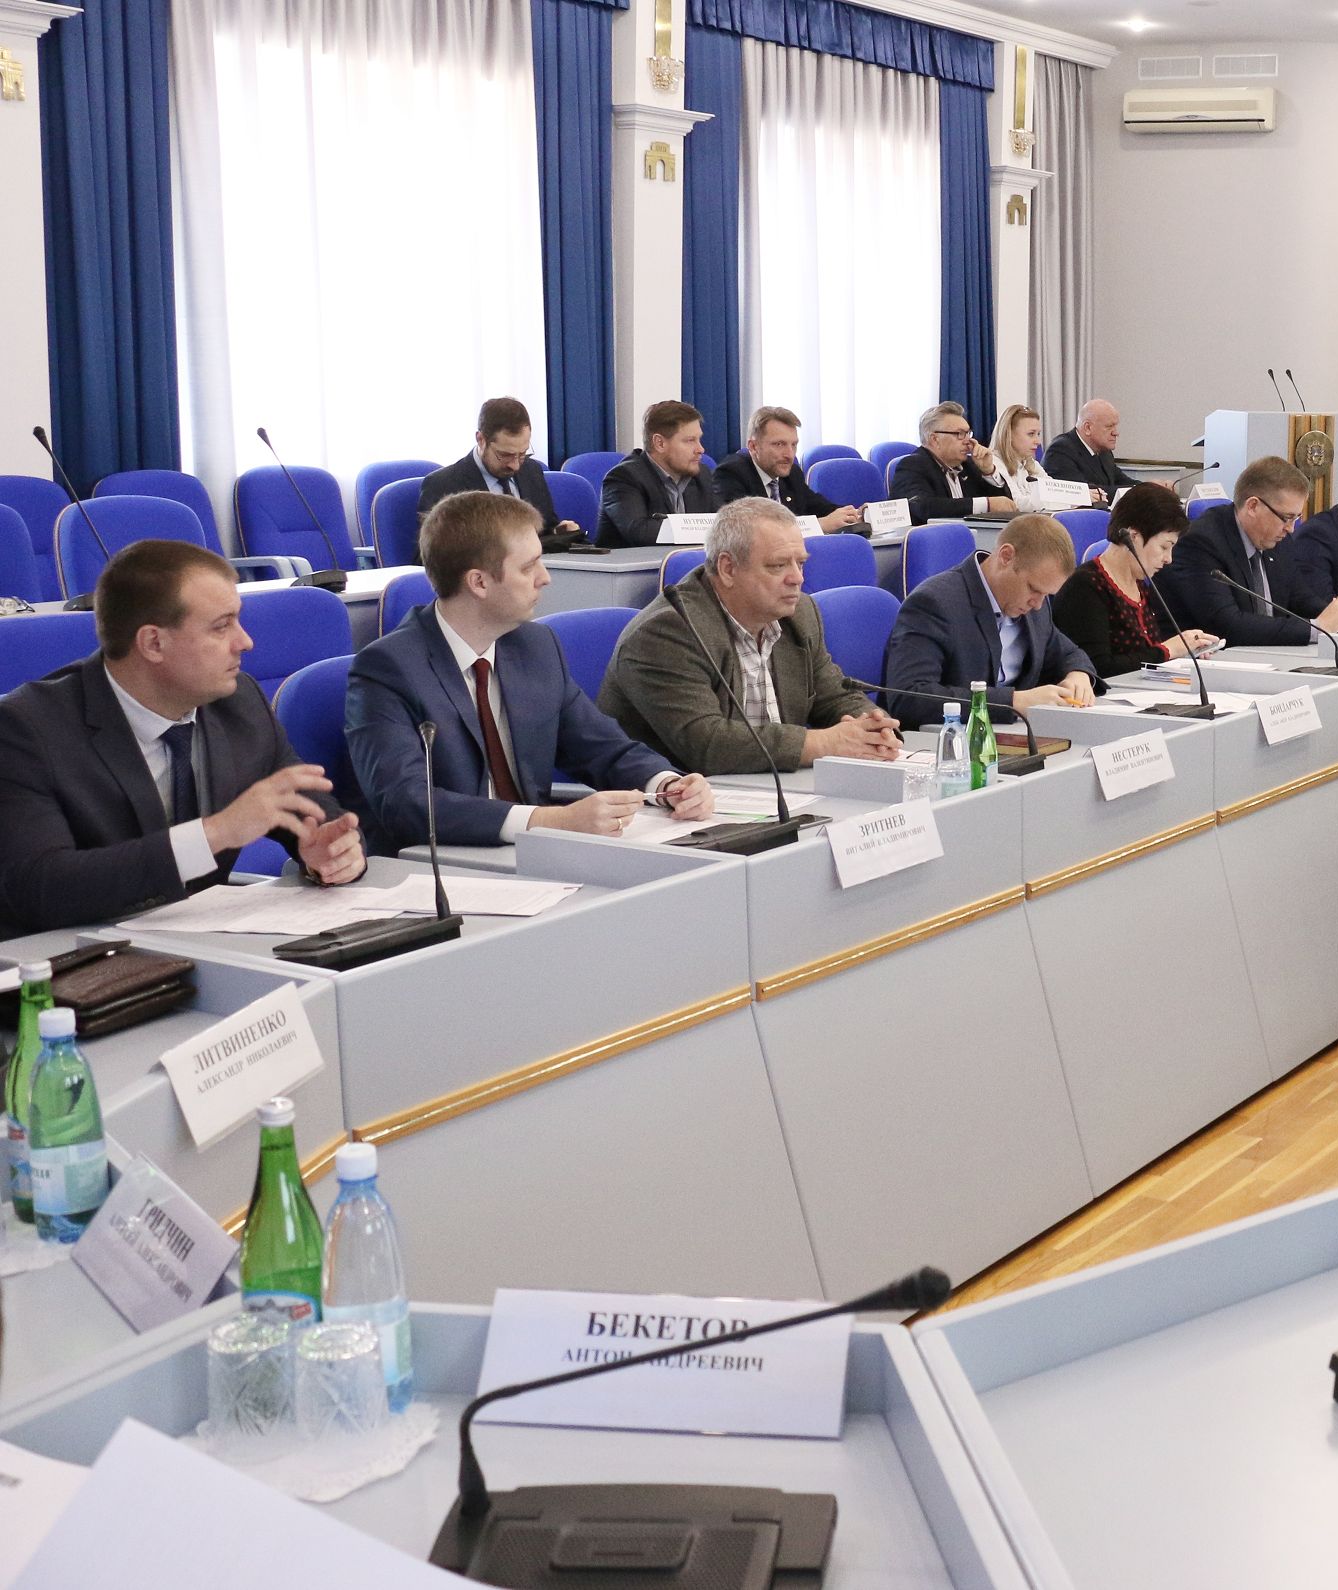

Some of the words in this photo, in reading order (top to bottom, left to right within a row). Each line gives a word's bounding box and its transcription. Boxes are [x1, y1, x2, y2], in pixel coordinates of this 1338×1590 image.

[1111, 742, 1151, 763] НЕСТЕРУК
[845, 838, 876, 856] ВИТАЛИЙ
[877, 825, 926, 847] ВЛАДИМИРОВИЧ
[858, 813, 906, 838] ЗРИТНЕВ
[193, 1009, 287, 1074] ЛИТВИНЕНКО
[196, 1060, 245, 1093] АЛЕКСАНДР
[246, 1030, 298, 1067] НИКОЛАЕВИЧ
[137, 1197, 196, 1263] ГРИДЧИН
[586, 1311, 750, 1343] БЕКЕТОВ
[561, 1347, 633, 1364] АНТОН
[641, 1350, 764, 1372] НДРЕЕВИЧ
